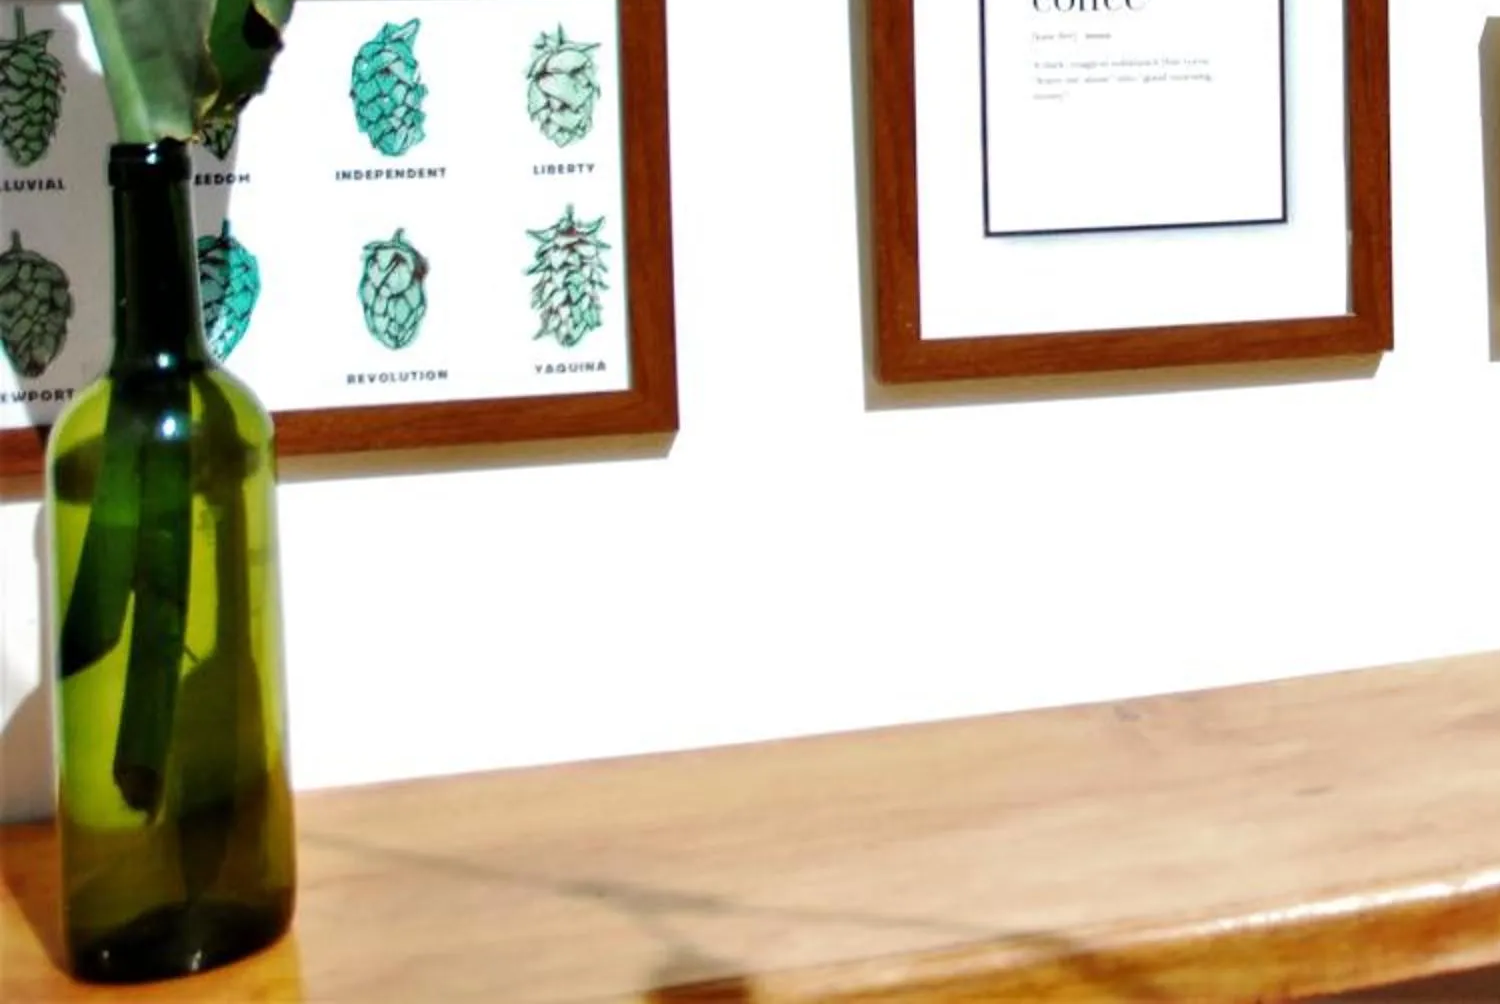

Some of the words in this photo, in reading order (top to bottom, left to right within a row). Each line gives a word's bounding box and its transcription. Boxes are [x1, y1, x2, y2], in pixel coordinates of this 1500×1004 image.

[335, 167, 447, 182] INDEPENDENT
[532, 163, 596, 176] LIBERTY
[0, 178, 66, 193] LUVIAL
[194, 172, 251, 186] EEDOM
[534, 360, 607, 375] YAQUINA
[346, 369, 449, 385] REVOLUTION
[0, 387, 76, 403] EWPORT
